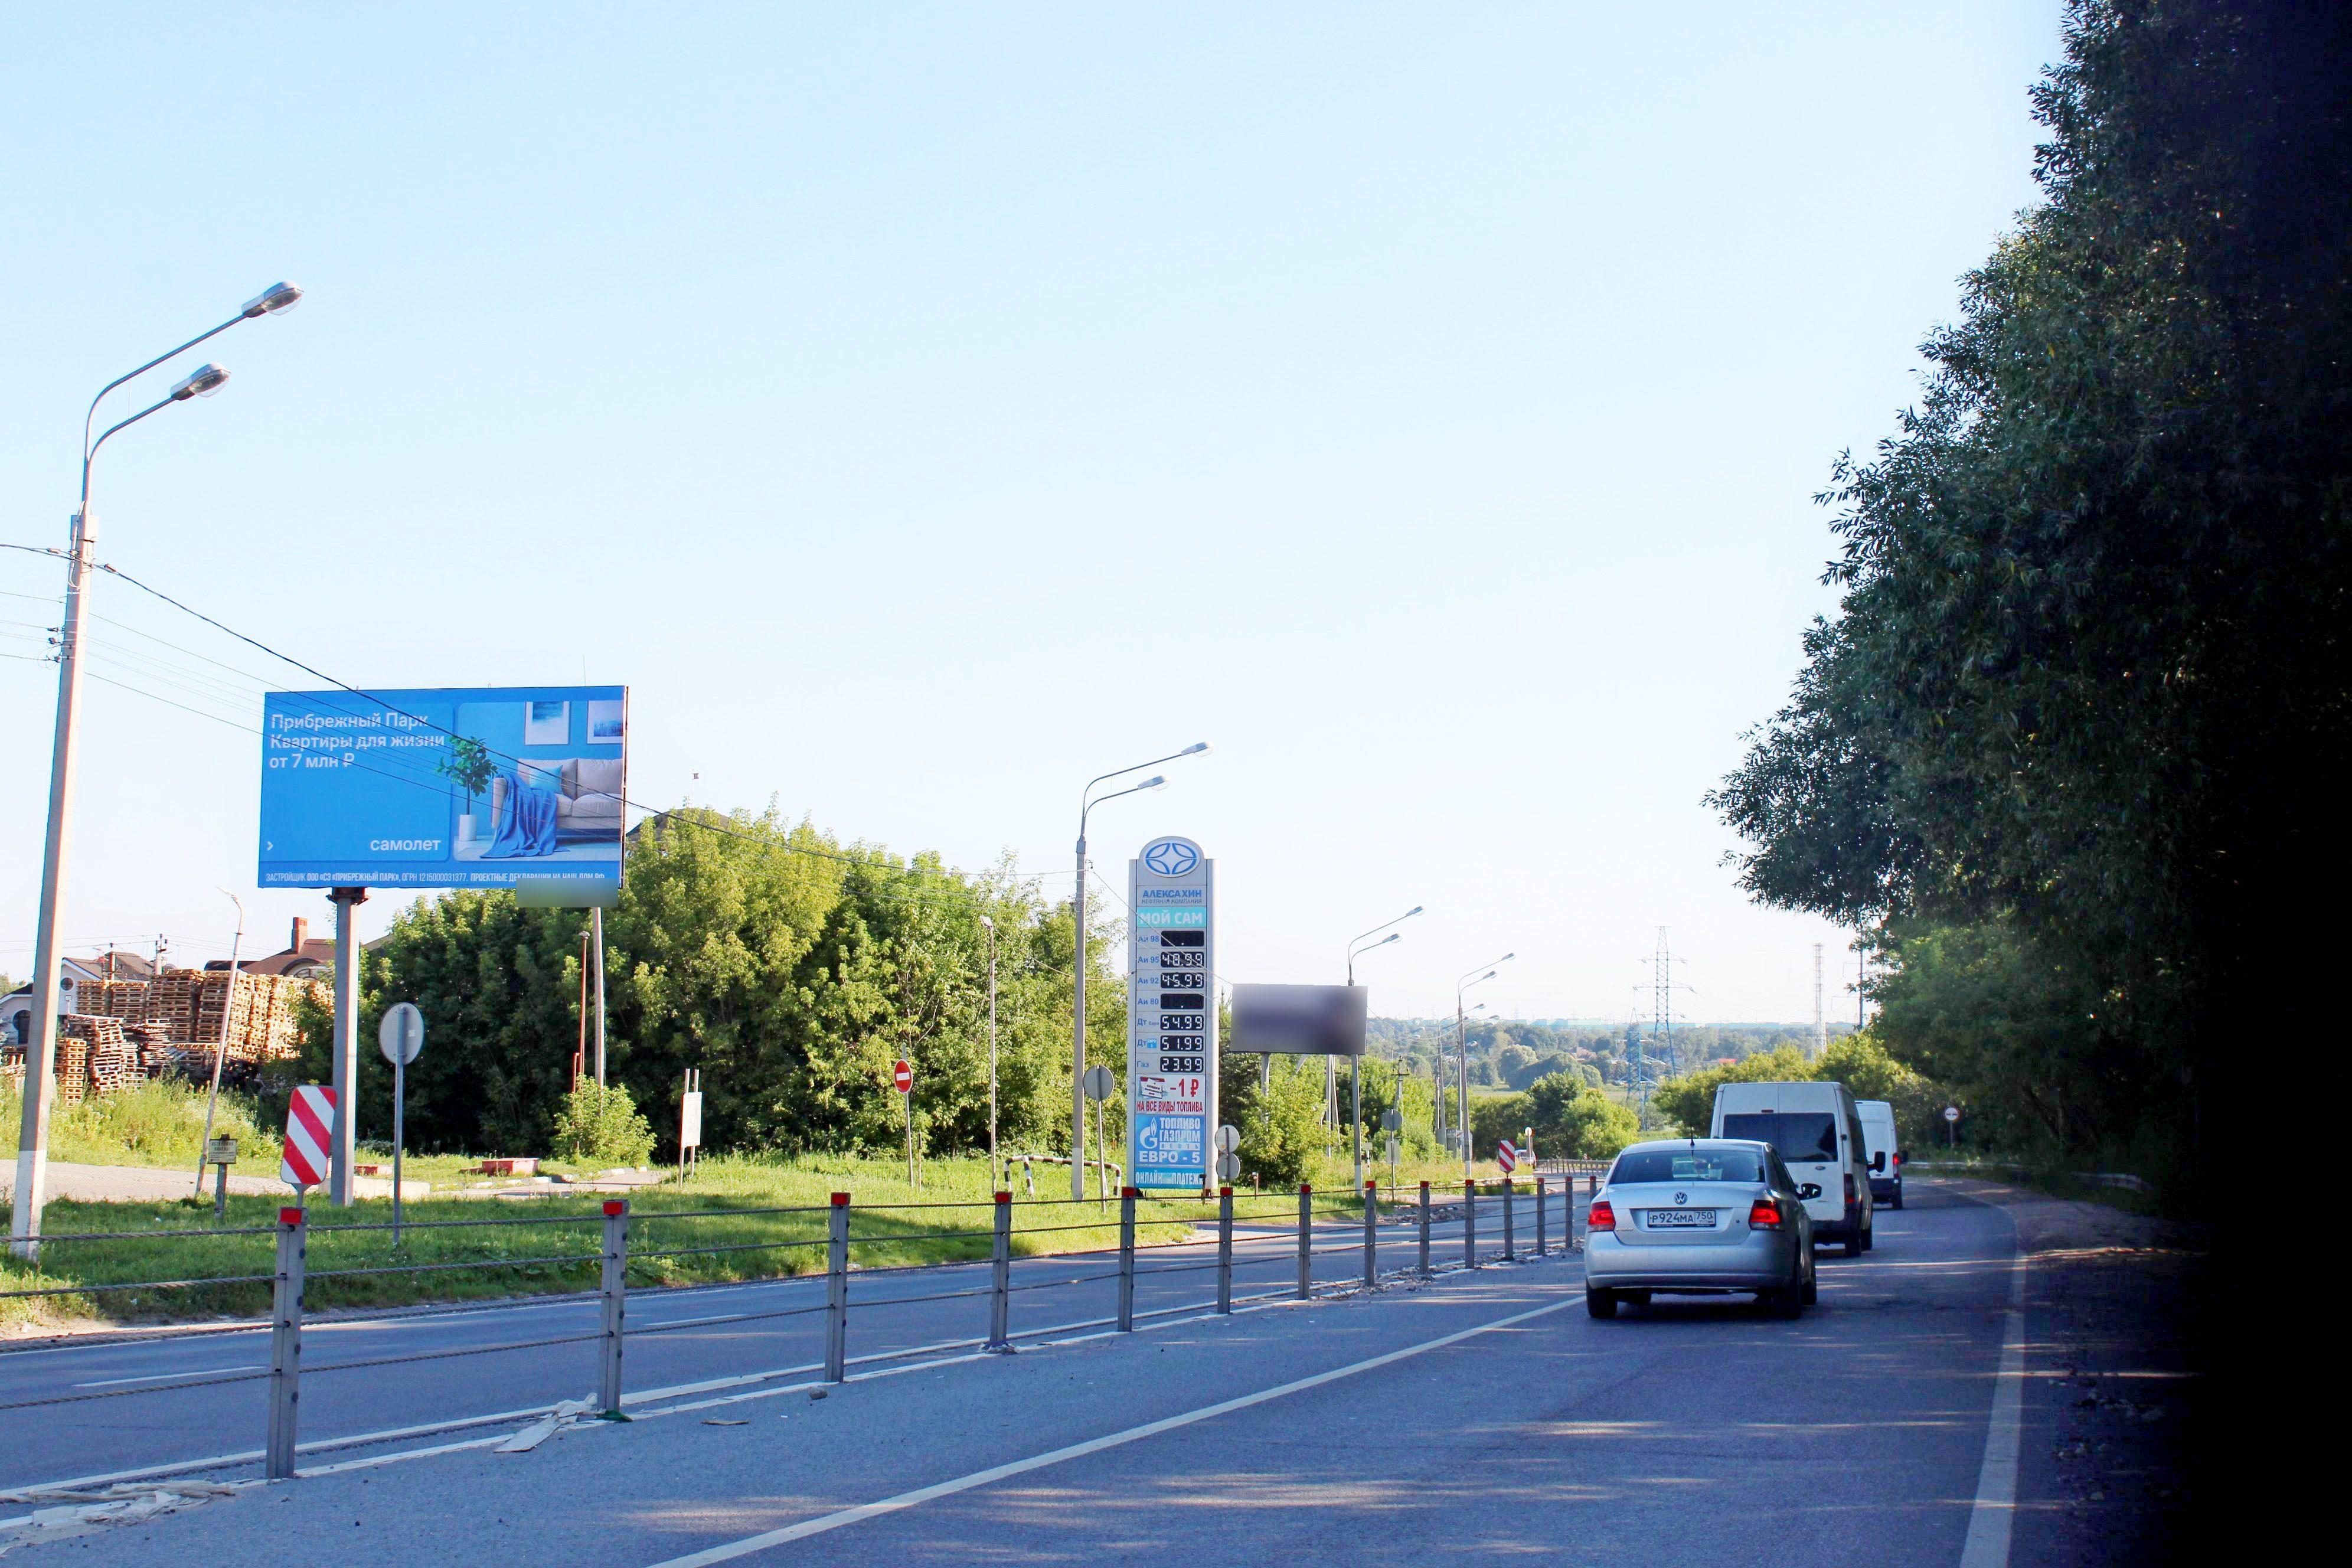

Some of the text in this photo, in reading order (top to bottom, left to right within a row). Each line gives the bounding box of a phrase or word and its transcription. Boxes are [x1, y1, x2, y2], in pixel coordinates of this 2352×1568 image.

[271, 712, 429, 732] Прибрежный Парк
[270, 734, 445, 750] Квартиры для жизни
[269, 757, 288, 768] от
[292, 753, 302, 768] 7
[306, 756, 338, 768] млн
[370, 839, 442, 851] самолет
[266, 872, 306, 882] ЗАСТРОЙЩИК
[307, 873, 319, 881] ООО
[402, 873, 417, 881] ОГРН
[471, 873, 508, 881] ПРОЕКТНЫЕ
[1142, 889, 1202, 898] АЛЕКСАХИН
[1140, 910, 1203, 925] МОЙ САМ
[1162, 974, 1203, 987] 45.99
[1137, 1018, 1146, 1026] Дт
[1162, 1015, 1203, 1029] 54.99
[1137, 1037, 1203, 1050] Дт 51.99
[1161, 1058, 1203, 1072] 23.99
[1137, 1100, 1203, 1113] НА ВСЕ ВИДЫ ТОПЛИВА
[1159, 1117, 1201, 1129] ТОПЛИВО
[1159, 1130, 1200, 1142] ГАЗПРОМ
[1139, 1151, 1178, 1163] ЕВРО
[1191, 1151, 1200, 1163] 5
[1135, 1170, 1162, 1184] ОНЛАЙН
